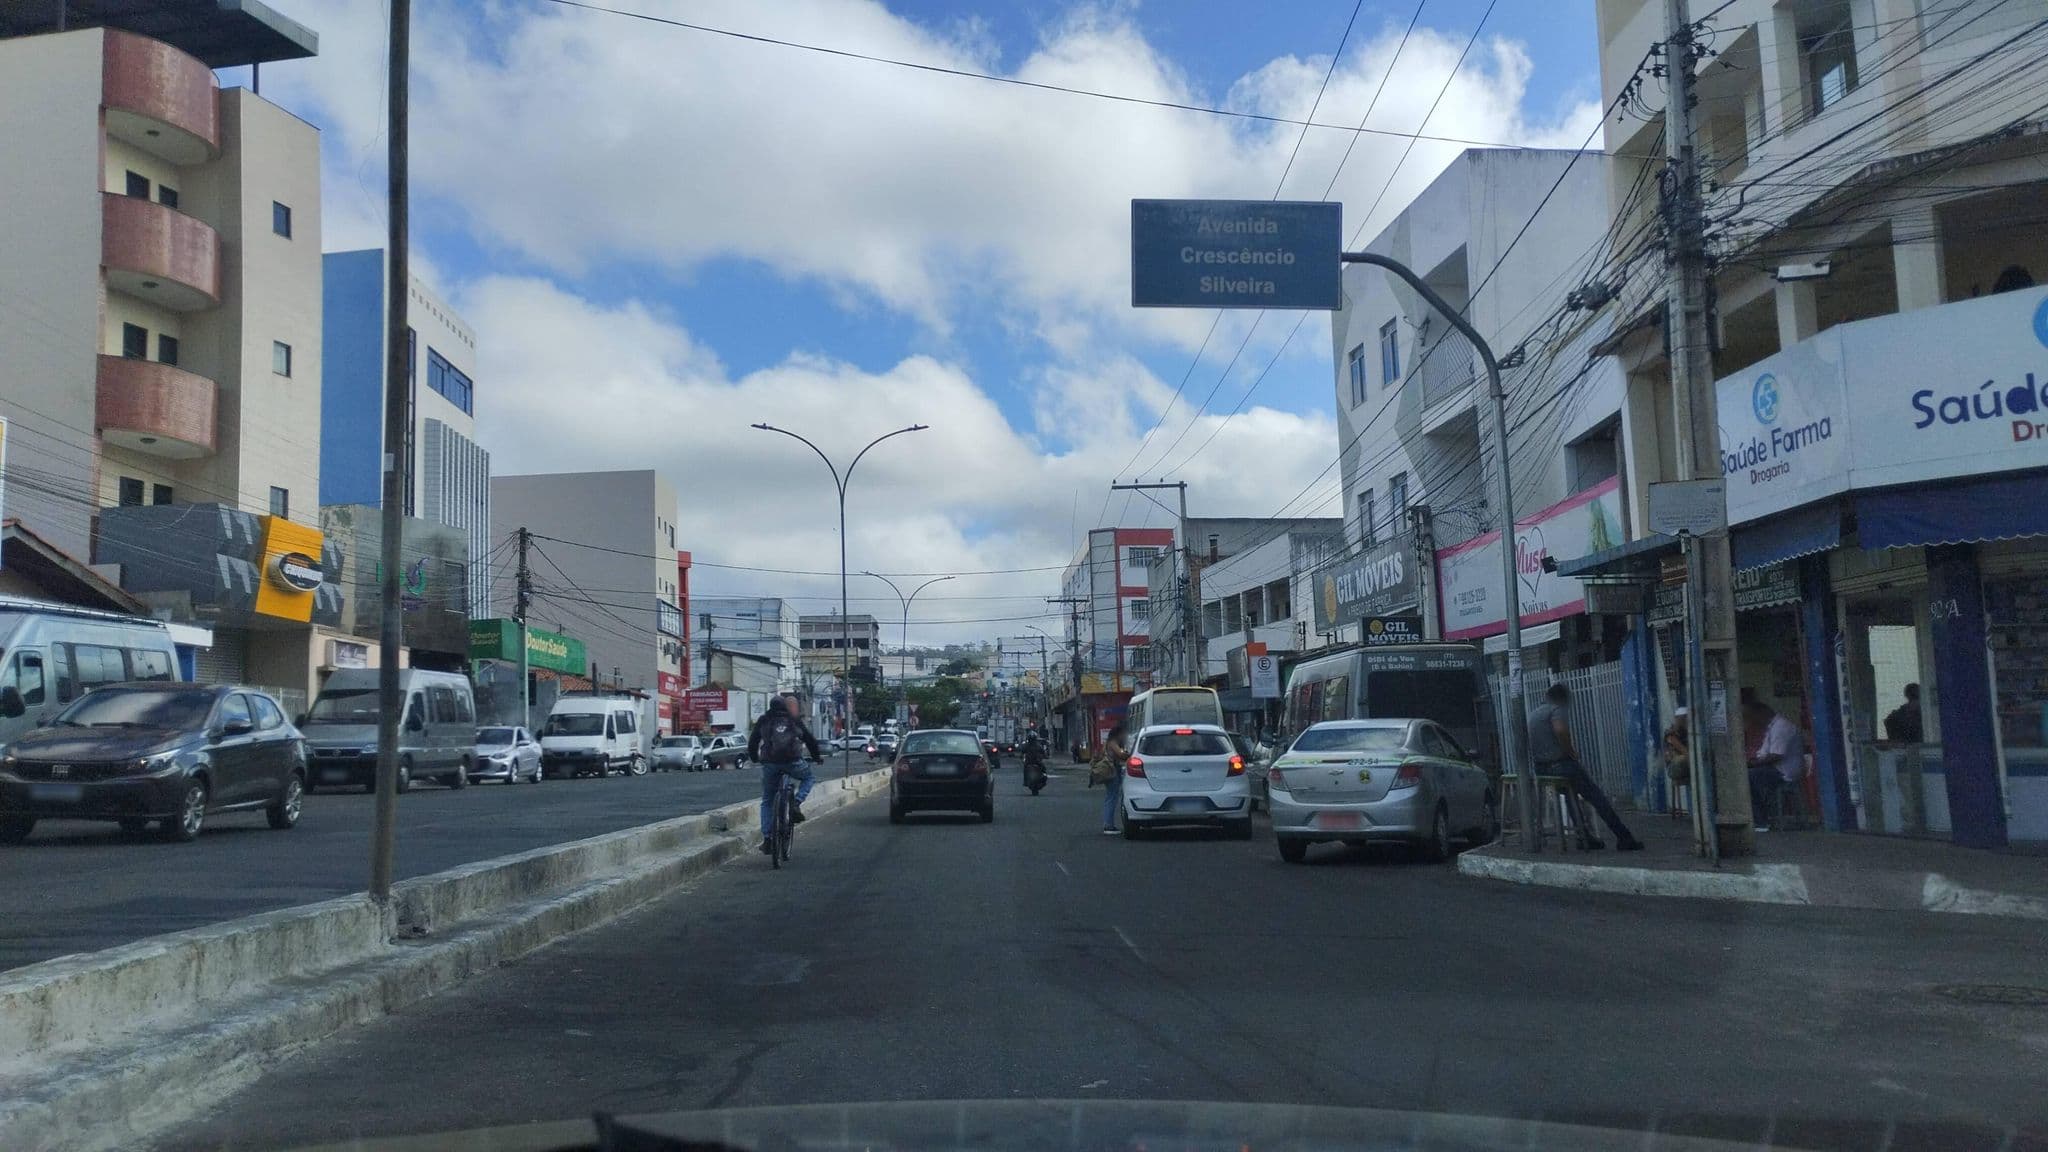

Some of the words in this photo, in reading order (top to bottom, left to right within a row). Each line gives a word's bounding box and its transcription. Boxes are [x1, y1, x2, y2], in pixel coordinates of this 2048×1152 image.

[1197, 217, 1279, 235] Avenida
[1181, 246, 1296, 265] Crescêncio
[1199, 276, 1275, 295] Silveira
[1771, 416, 1832, 458] Farma
[2012, 419, 2048, 442] Dr
[1750, 460, 1790, 485] Drogaria
[1336, 573, 1355, 605] GIL
[1355, 551, 1404, 599] MÓVEIS
[1520, 599, 1549, 616] Noivas
[1385, 621, 1409, 632] GIL
[1368, 631, 1420, 642] MÓVEIS
